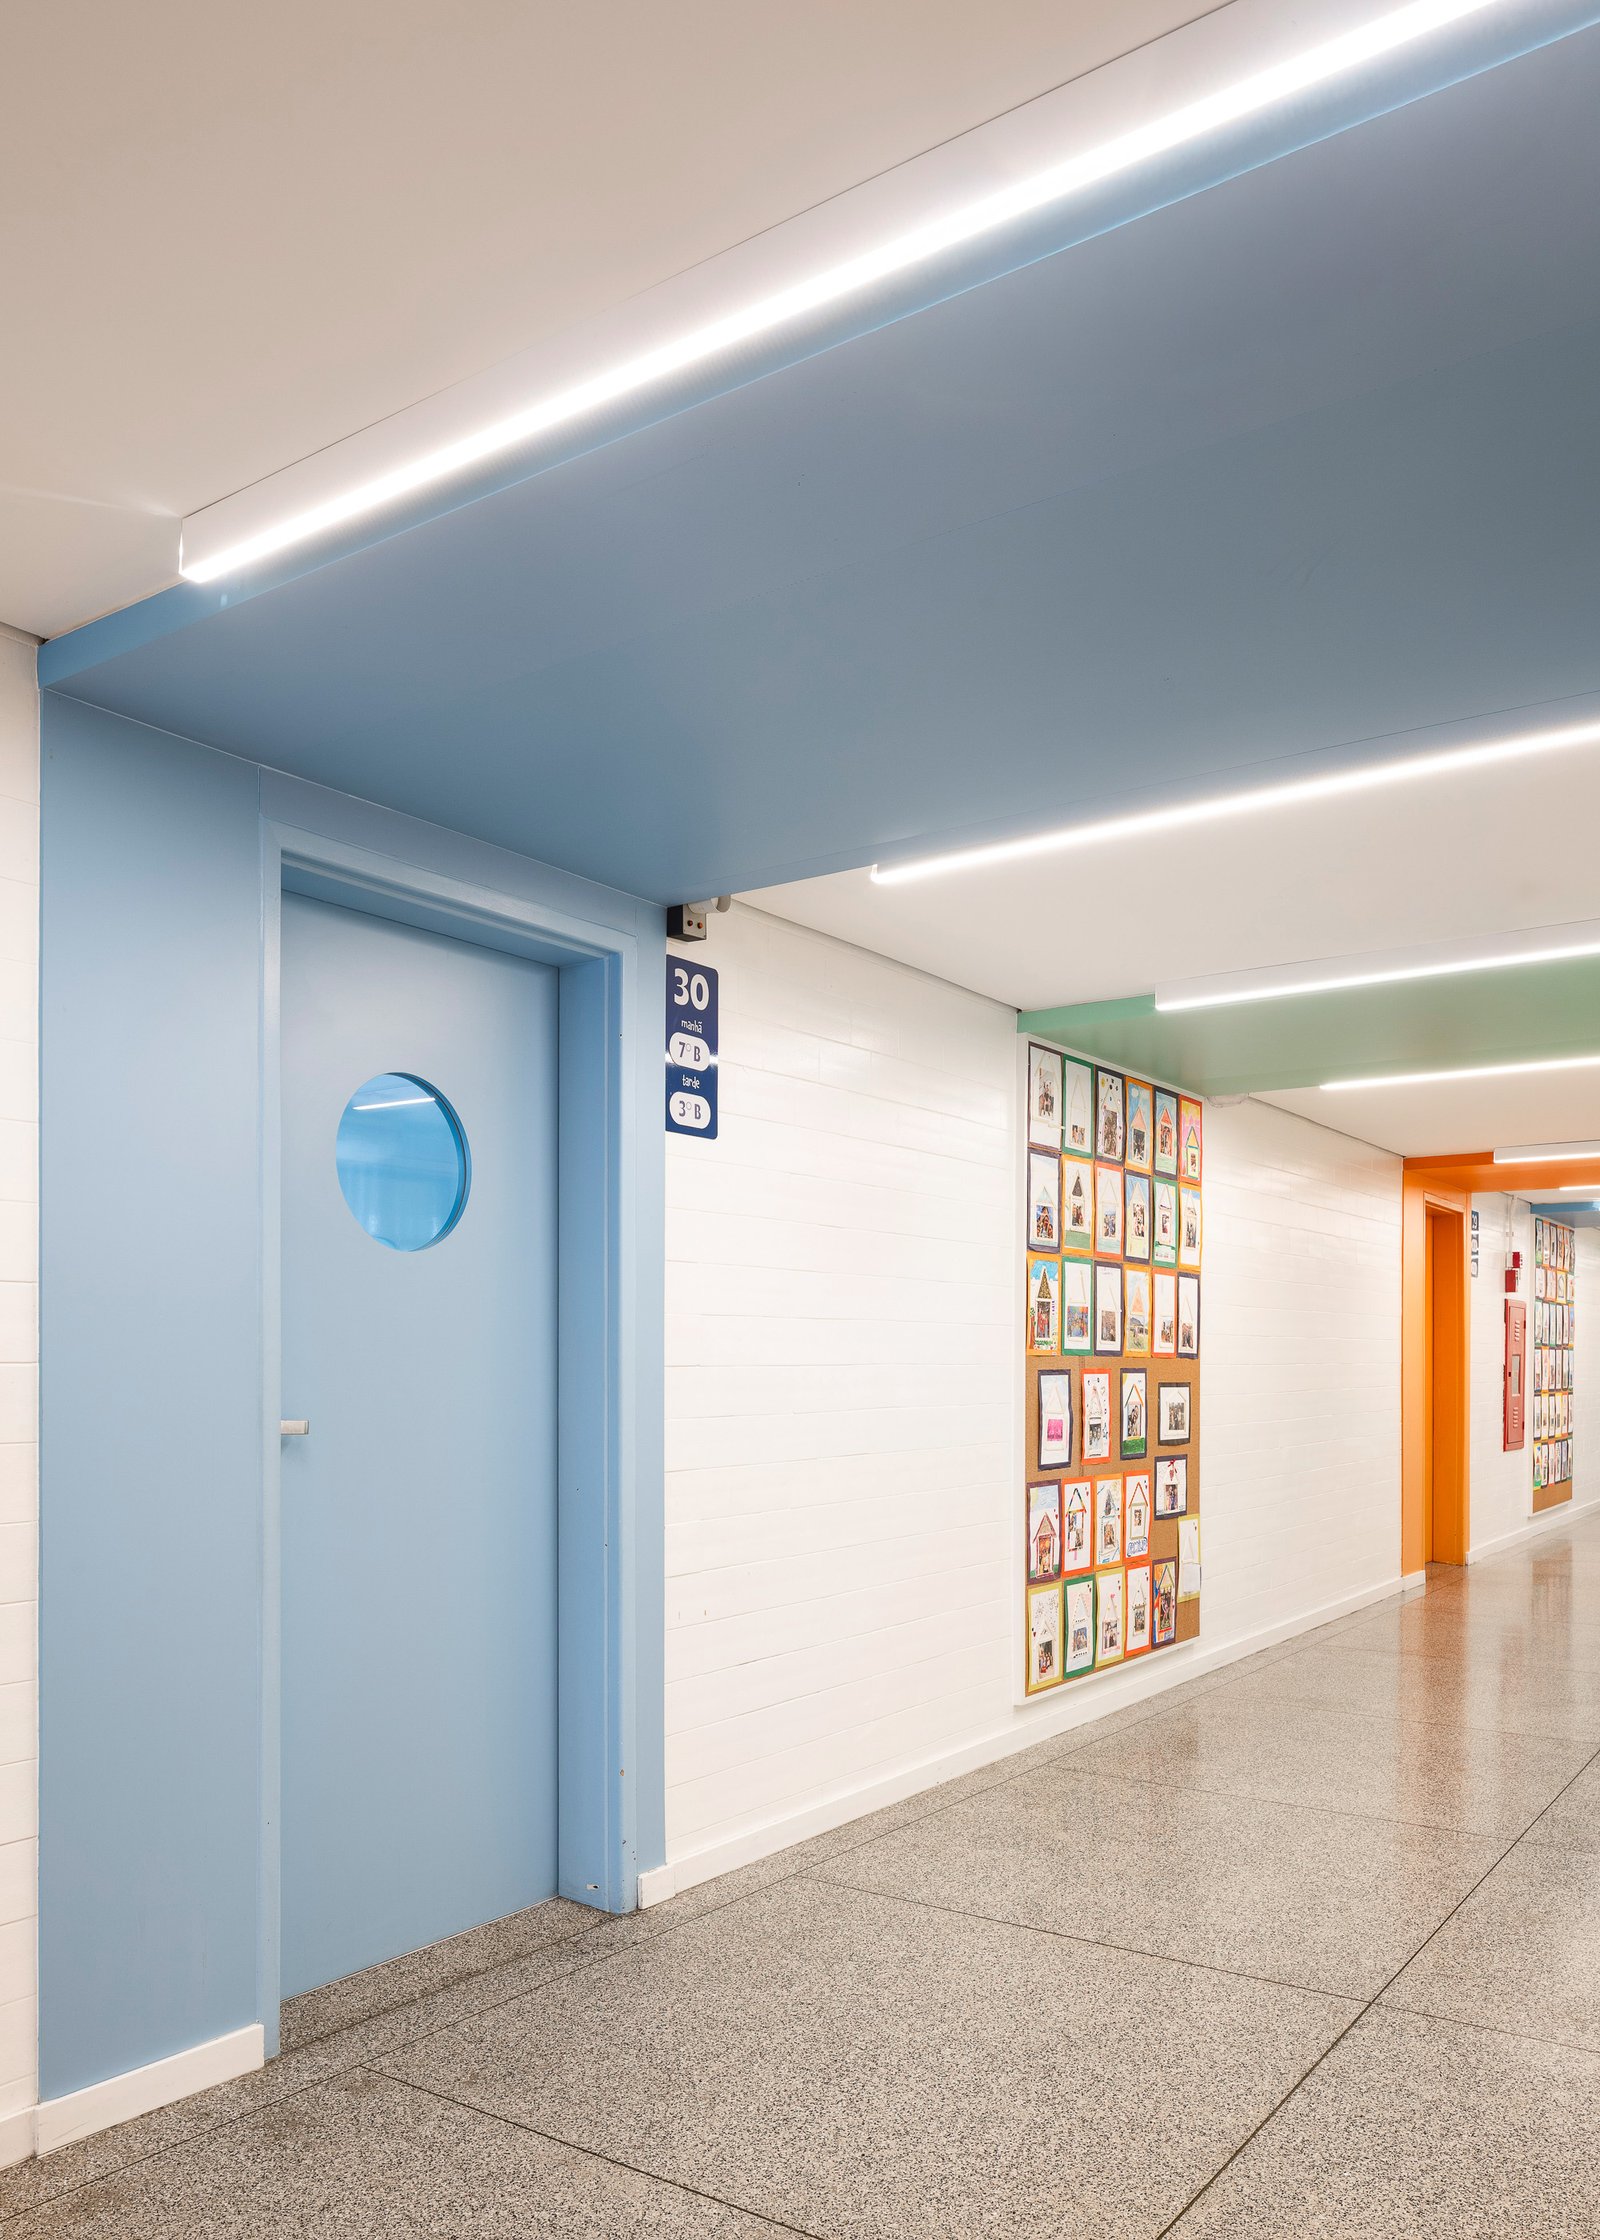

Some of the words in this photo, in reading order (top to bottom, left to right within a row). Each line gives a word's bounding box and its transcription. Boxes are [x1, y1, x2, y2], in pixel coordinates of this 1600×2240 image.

[674, 968, 709, 1010] 30
[681, 1020, 703, 1034] manhã
[694, 1046, 701, 1062] B
[682, 1075, 700, 1089] tarde
[694, 1104, 701, 1120] B
